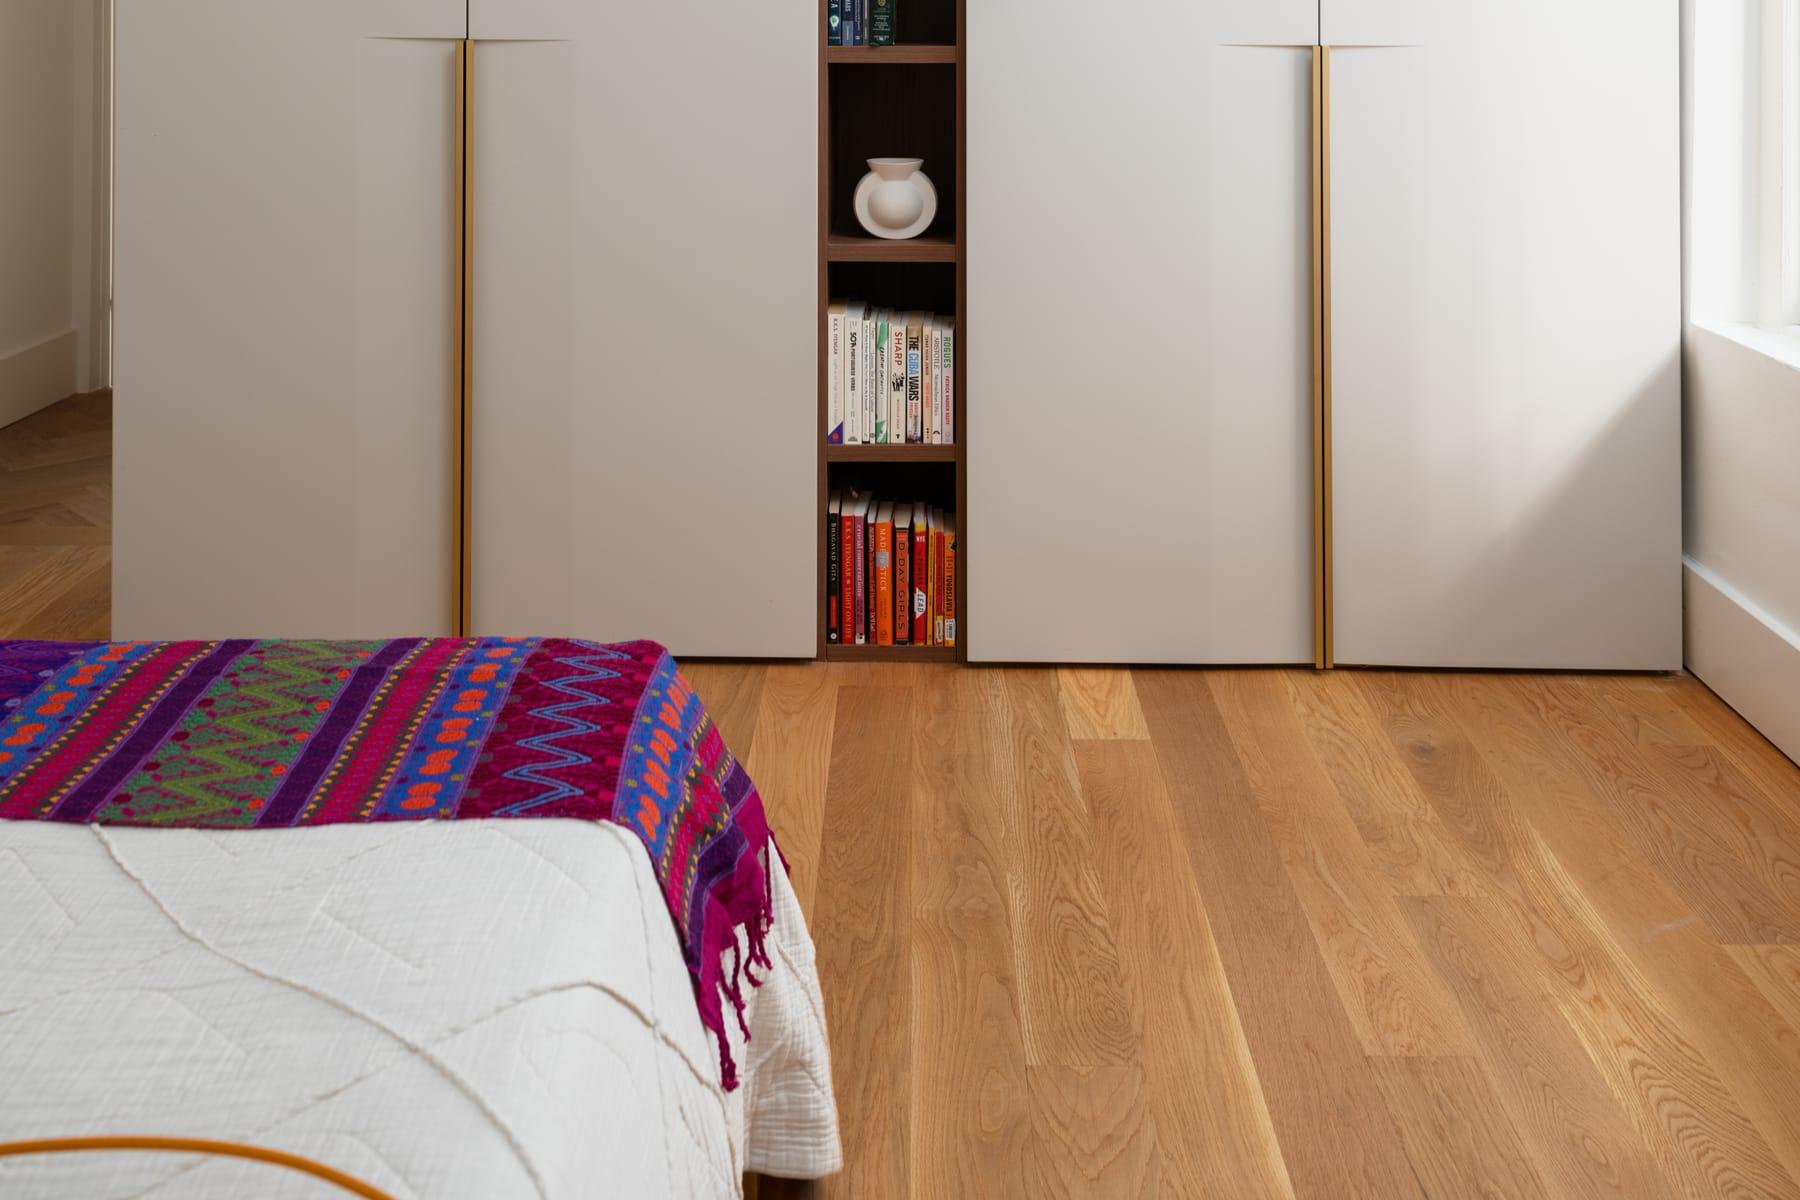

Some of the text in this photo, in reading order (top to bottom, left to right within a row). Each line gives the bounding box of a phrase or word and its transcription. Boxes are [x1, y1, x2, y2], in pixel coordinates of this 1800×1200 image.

[909, 336, 919, 351] THE
[909, 353, 919, 375] CUBA
[909, 376, 919, 401] WARS
[845, 611, 850, 622] ON
